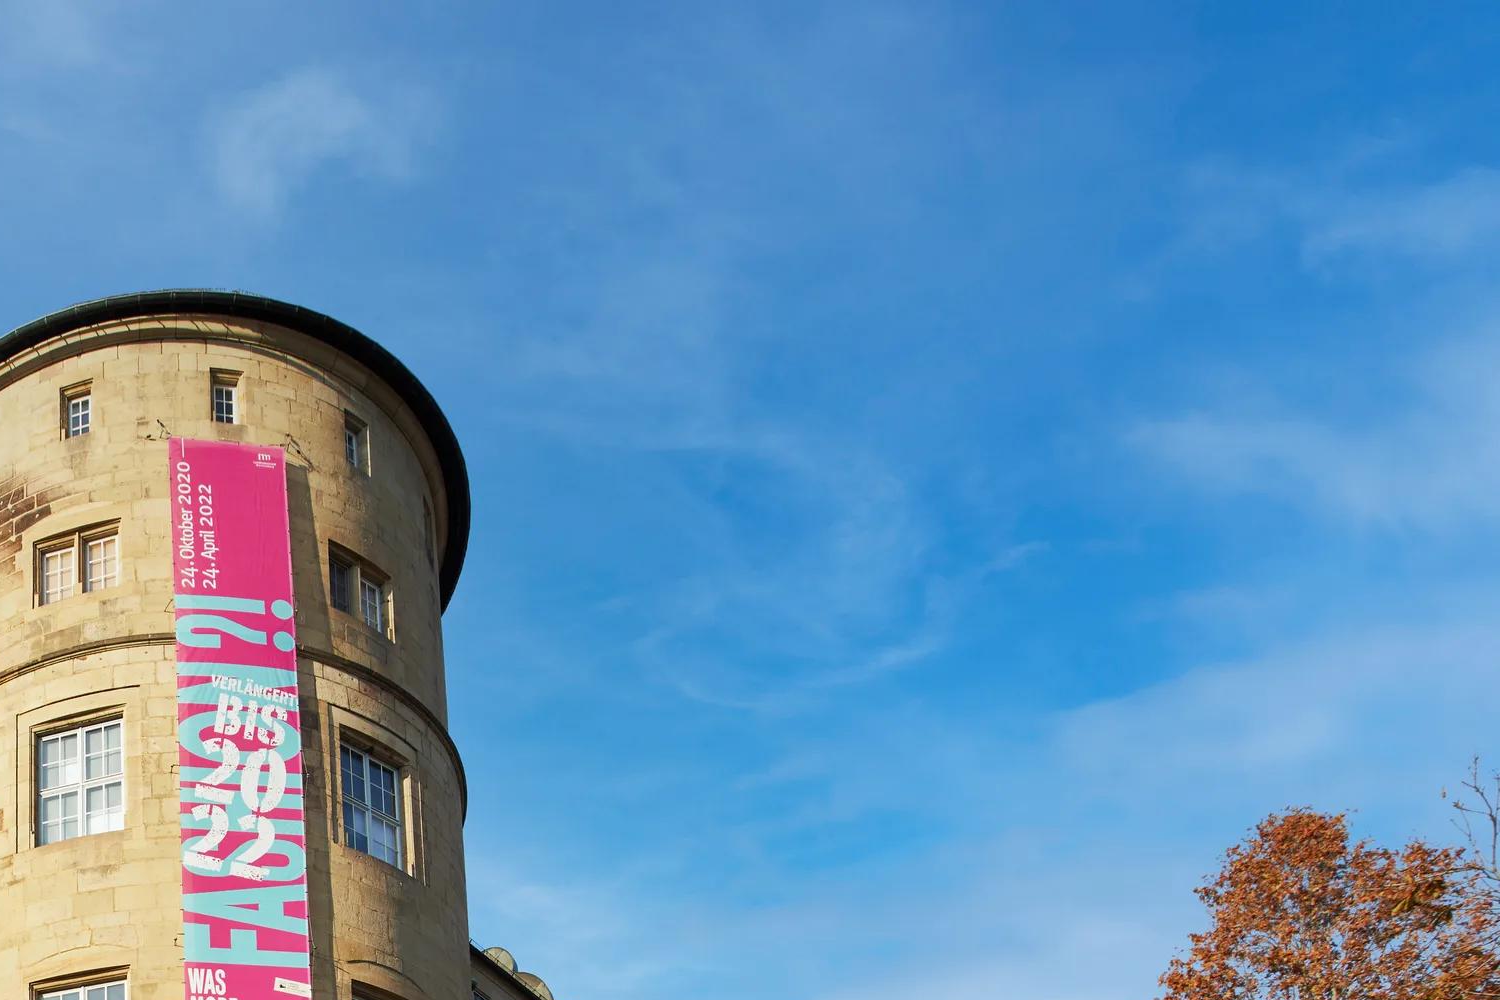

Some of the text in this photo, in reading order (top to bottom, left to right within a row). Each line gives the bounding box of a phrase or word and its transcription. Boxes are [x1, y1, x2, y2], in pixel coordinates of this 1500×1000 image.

[177, 461, 191, 504] 2020
[178, 509, 193, 559] Oktober
[197, 484, 220, 589] 24. April 2022
[181, 561, 198, 588] 24.
[214, 693, 288, 746] BIS
[195, 737, 287, 813] 20
[183, 804, 276, 881] 22
[187, 967, 227, 996] WAS
